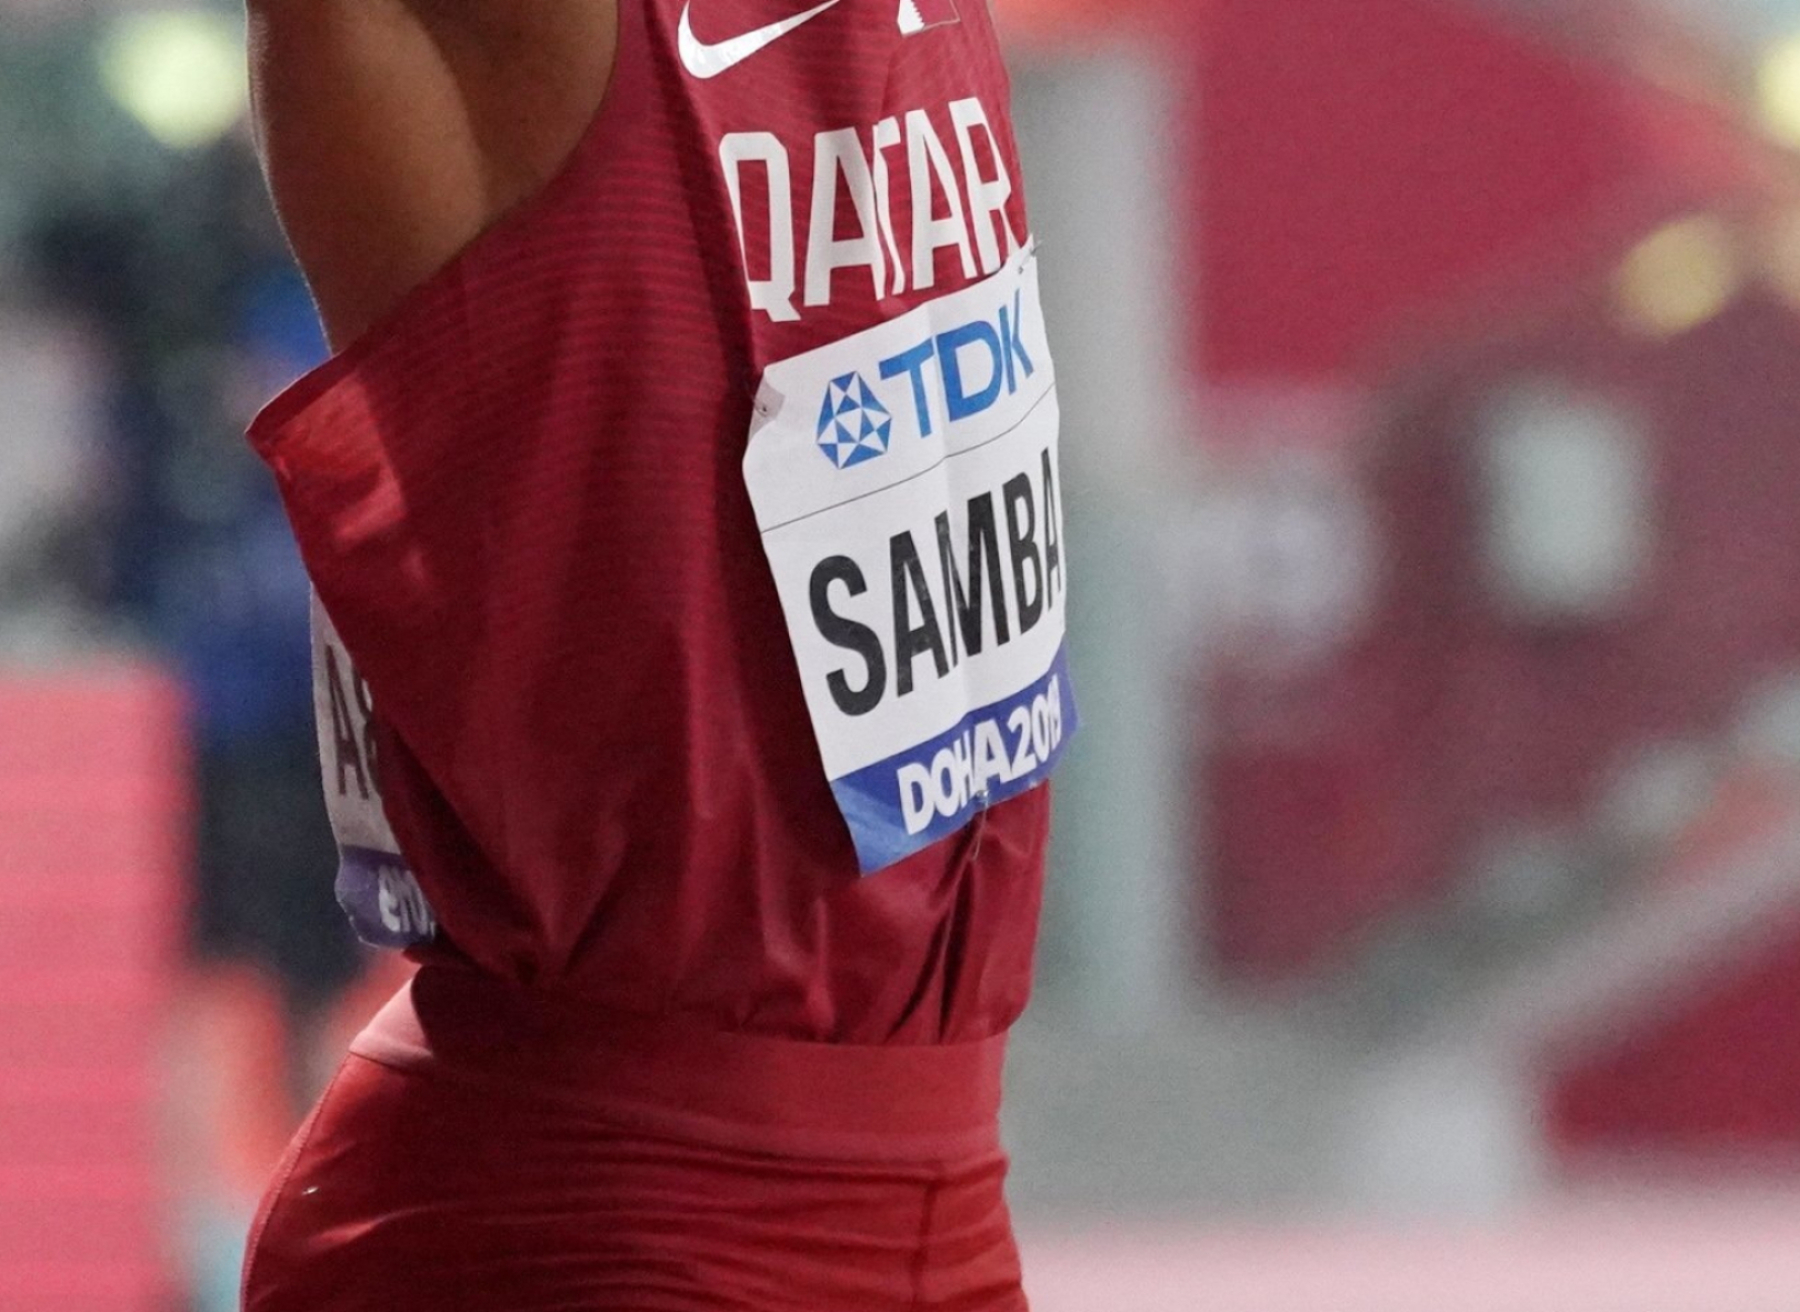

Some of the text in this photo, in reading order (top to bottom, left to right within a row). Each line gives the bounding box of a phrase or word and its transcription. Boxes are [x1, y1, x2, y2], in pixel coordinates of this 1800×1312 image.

[719, 97, 1022, 322] QATAR
[878, 288, 1034, 438] TDK
[809, 446, 1062, 716] SAMBA
